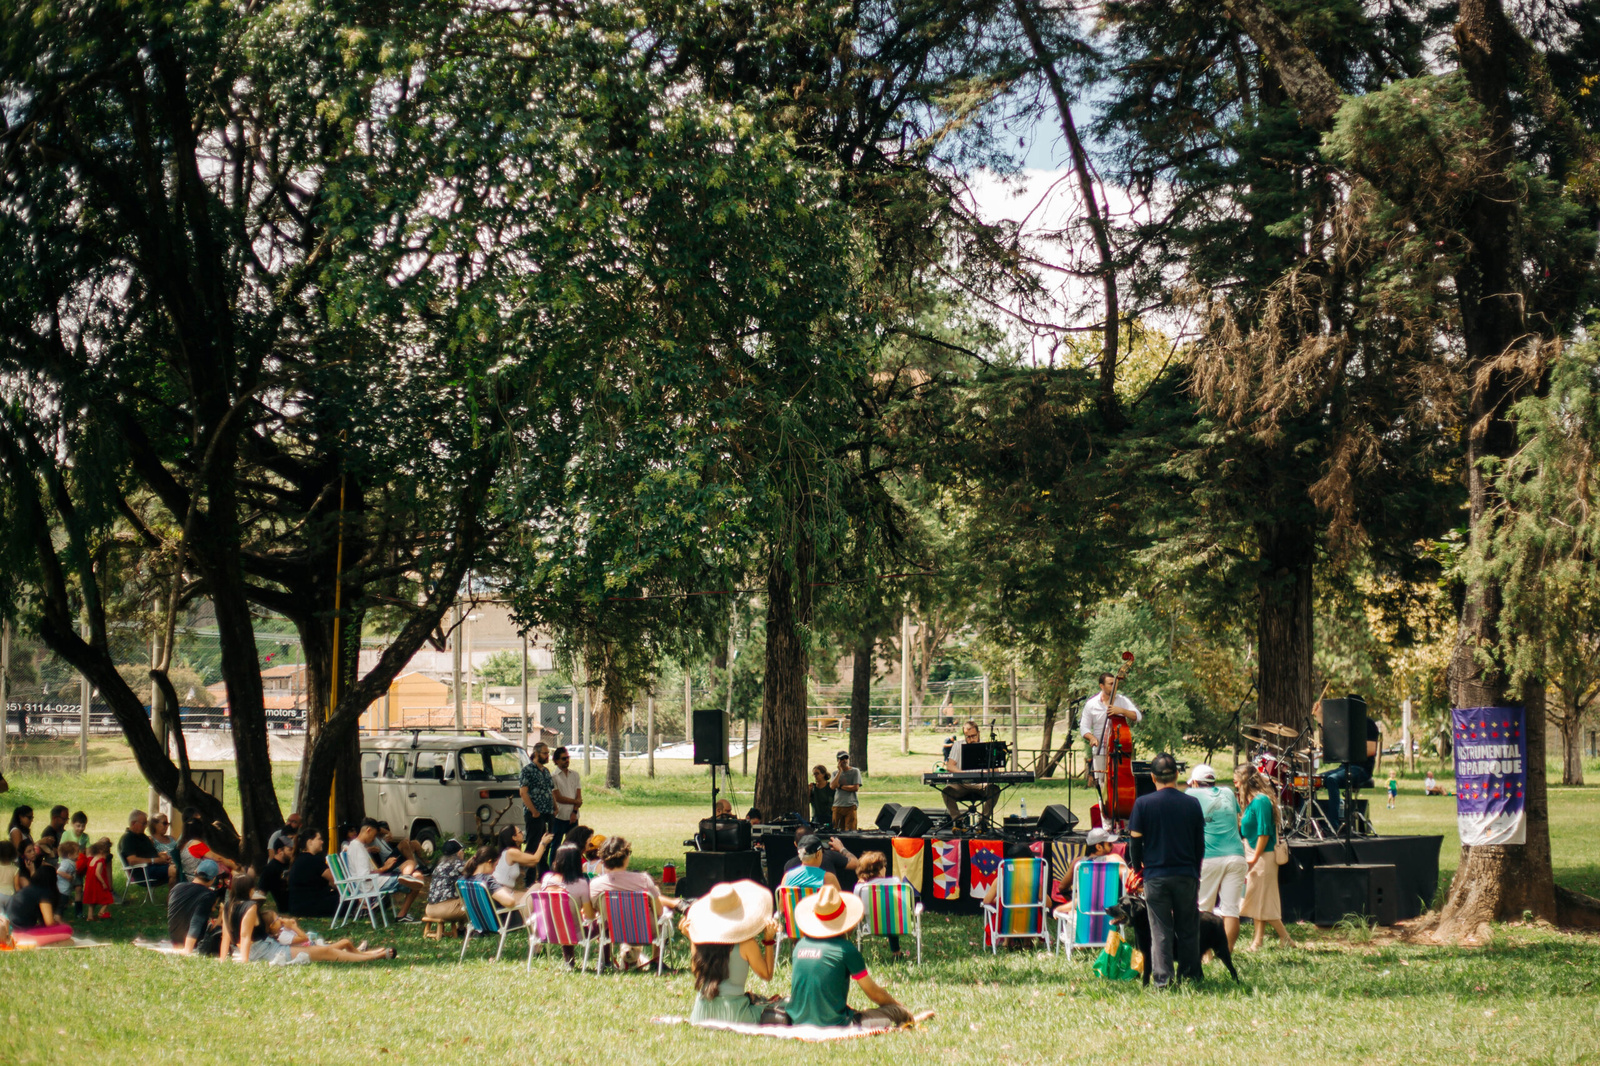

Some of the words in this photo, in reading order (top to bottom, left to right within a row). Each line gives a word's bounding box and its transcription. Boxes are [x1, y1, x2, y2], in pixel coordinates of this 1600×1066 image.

[25, 704, 82, 713] 3114-0222
[1467, 760, 1522, 778] PARQUE
[797, 948, 822, 959] CARTOLA
